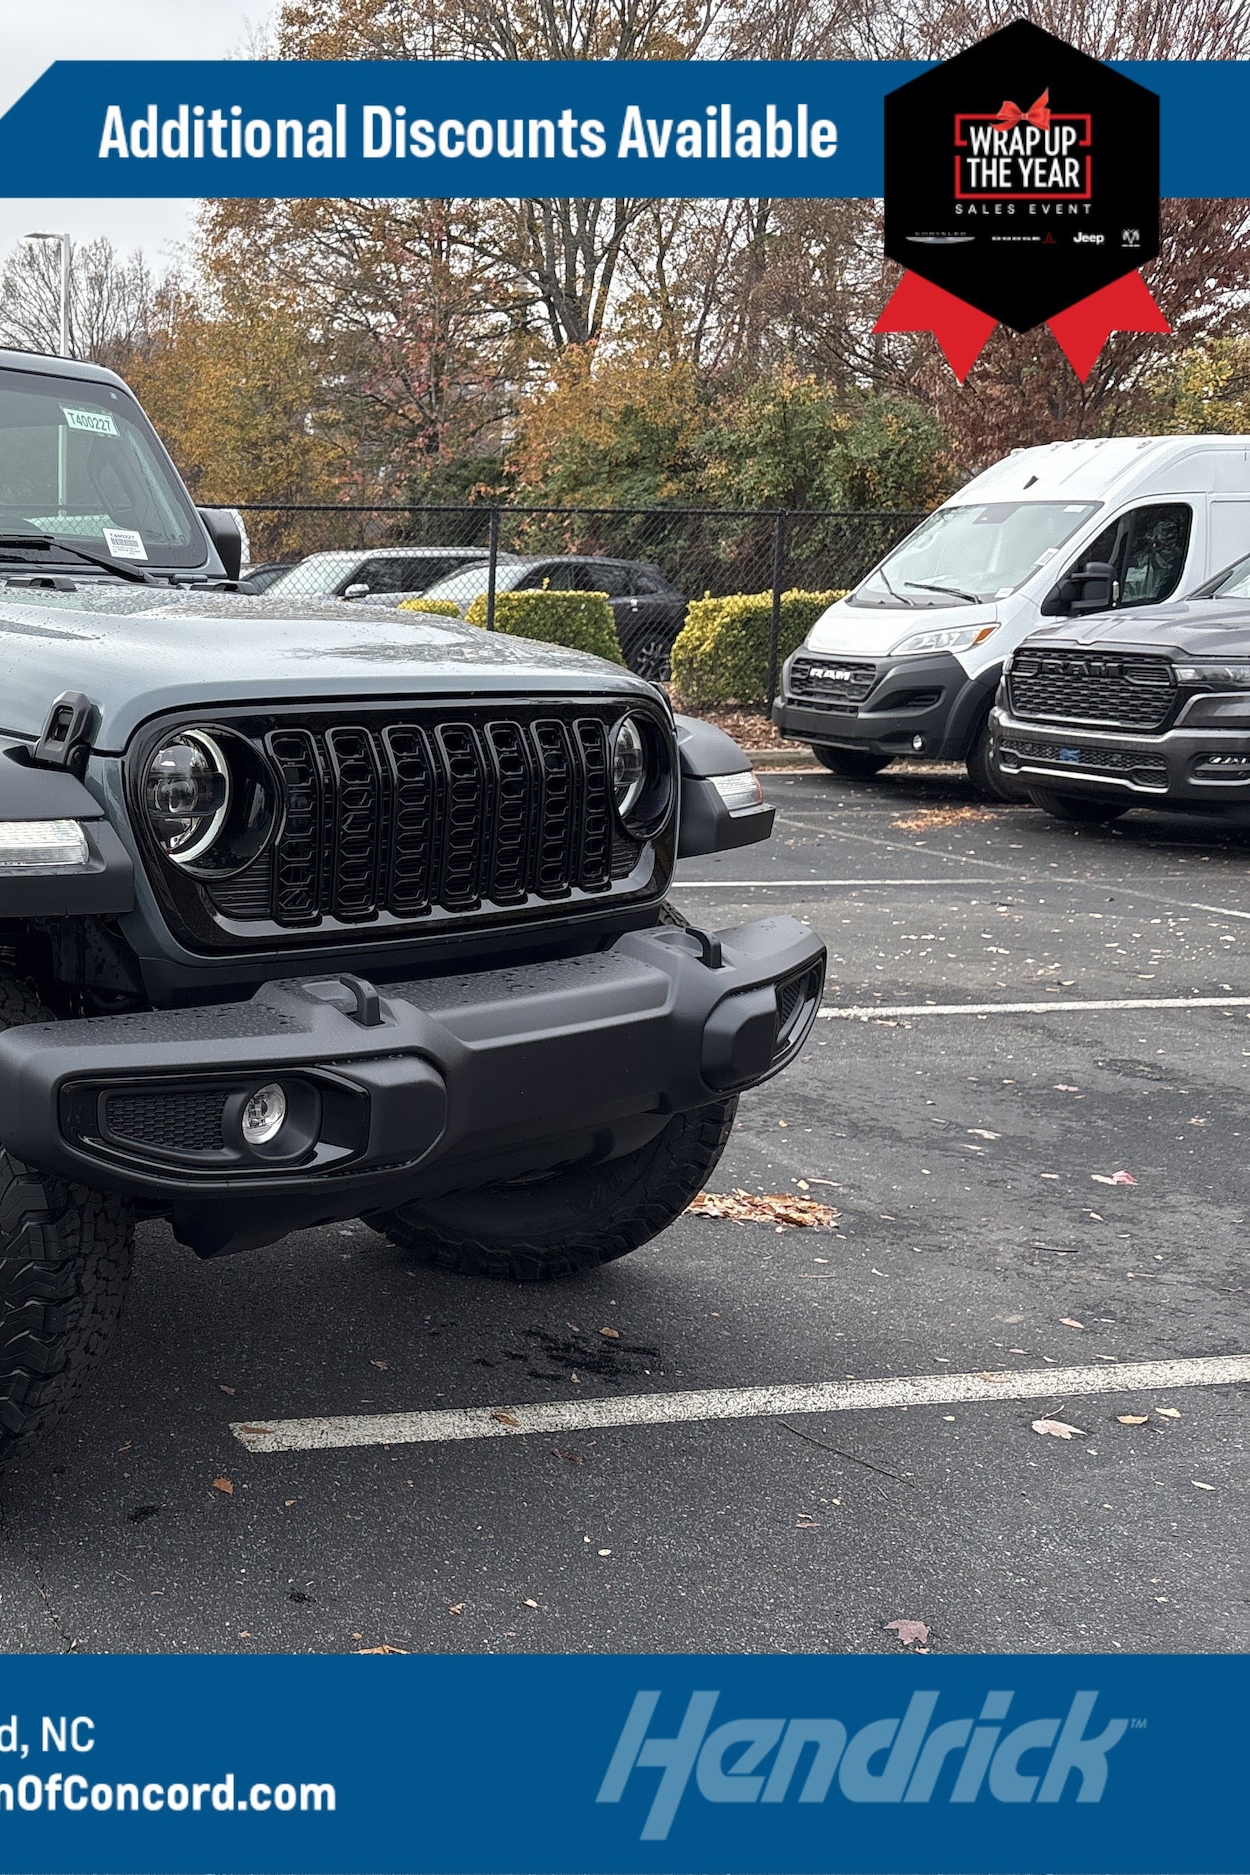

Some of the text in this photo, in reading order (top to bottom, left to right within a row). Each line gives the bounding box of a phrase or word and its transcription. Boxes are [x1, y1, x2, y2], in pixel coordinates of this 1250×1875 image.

[67, 412, 111, 431] T400227
[809, 667, 851, 681] RAM
[1042, 659, 1123, 678] RAM
